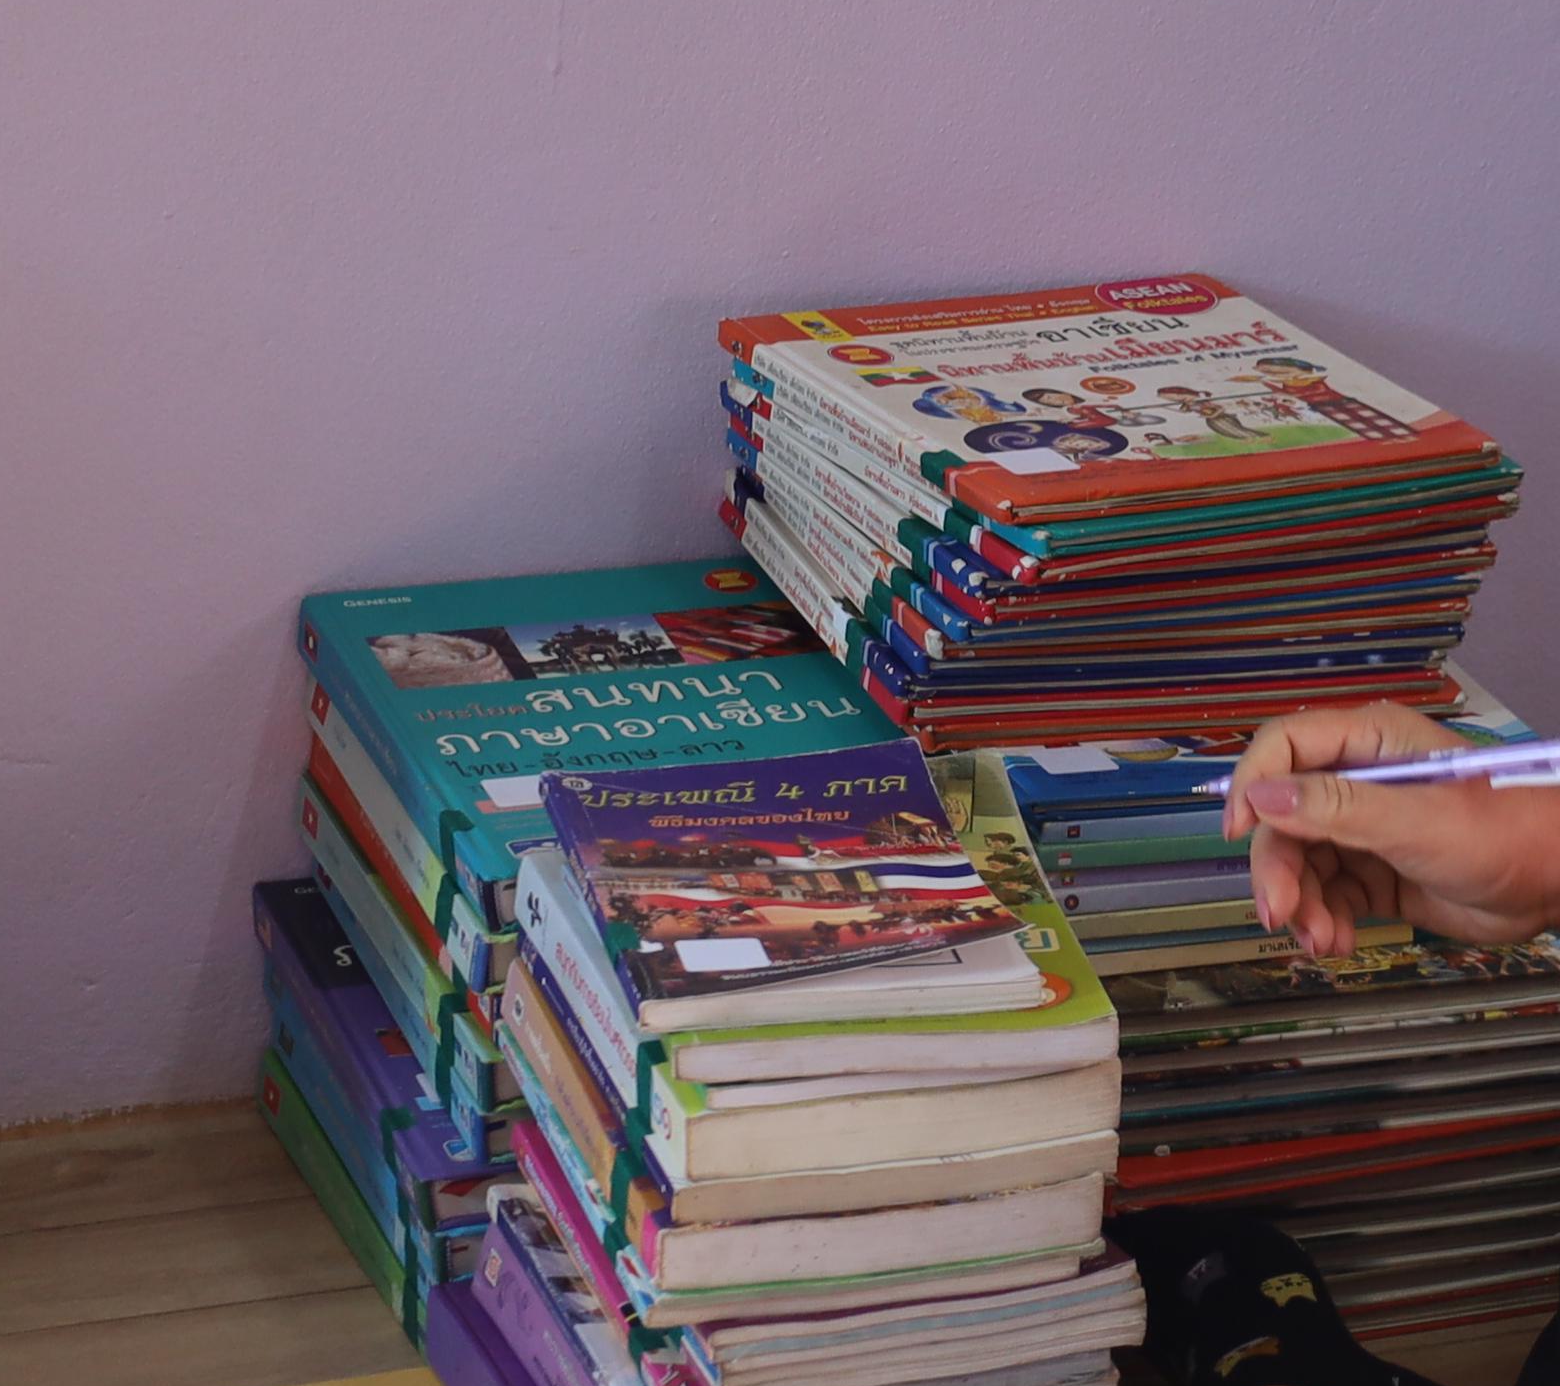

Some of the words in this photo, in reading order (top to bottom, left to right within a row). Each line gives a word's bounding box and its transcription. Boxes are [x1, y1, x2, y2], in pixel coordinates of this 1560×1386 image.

[1107, 281, 1193, 302] ASEAN
[1124, 293, 1209, 311] Folktales
[1036, 314, 1188, 345] อาเซียน
[1089, 357, 1178, 374] Folktales
[1210, 344, 1301, 364] Myanmar
[343, 595, 412, 609] GENESIS
[525, 668, 786, 714] สนทนา
[435, 696, 864, 758] ภาษาอาเซียน
[578, 779, 756, 810] ประเพณี
[823, 773, 909, 799] ภาค
[647, 807, 850, 829] พิธีมงคลของไทย
